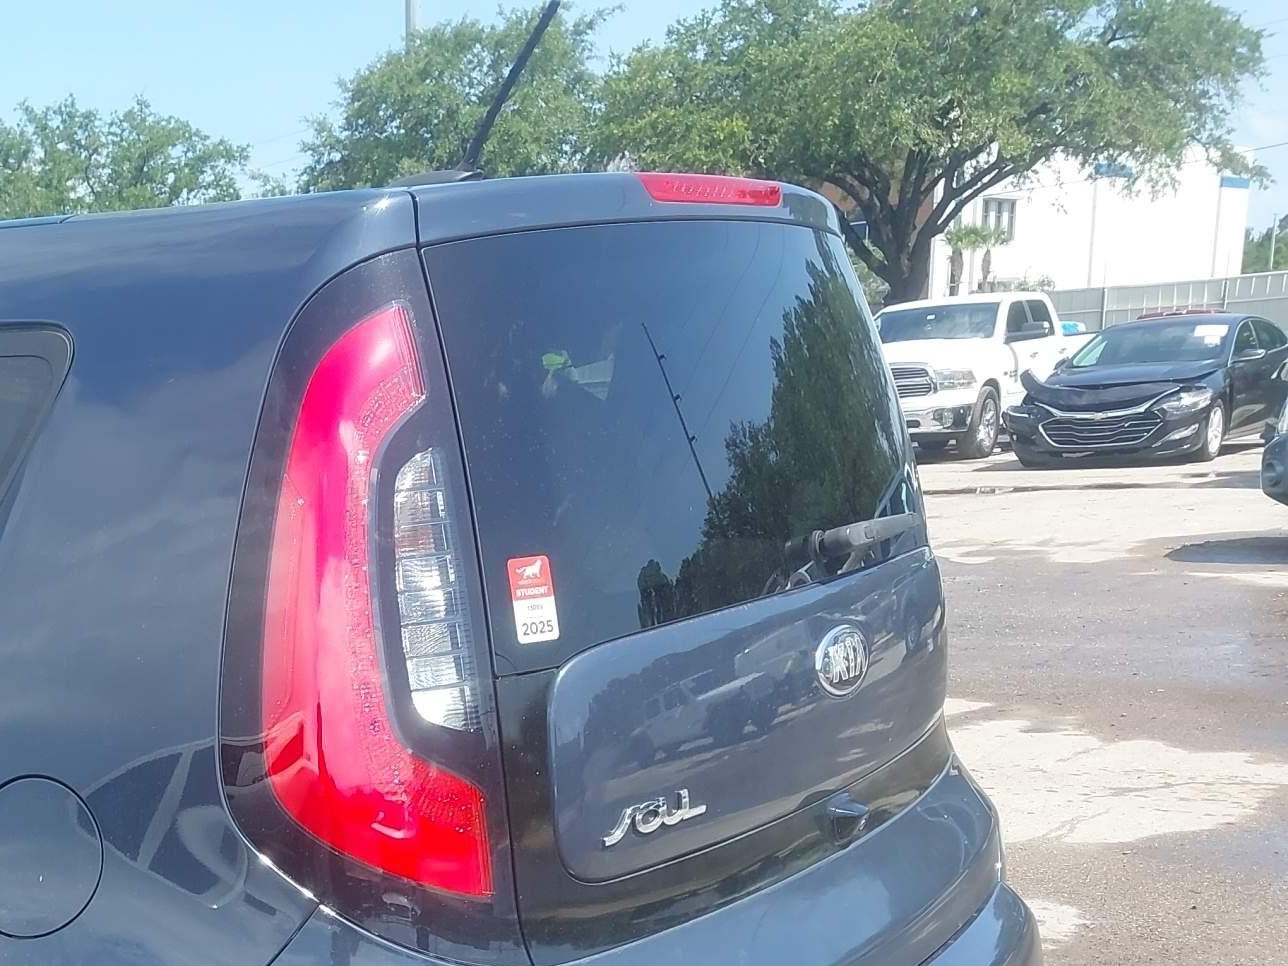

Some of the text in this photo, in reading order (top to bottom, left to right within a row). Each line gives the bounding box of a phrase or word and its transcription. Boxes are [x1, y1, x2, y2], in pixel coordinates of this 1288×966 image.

[516, 585, 549, 597] STUDENT
[522, 620, 554, 636] 2025
[828, 635, 866, 684] KIA
[601, 788, 707, 848] SOUL
